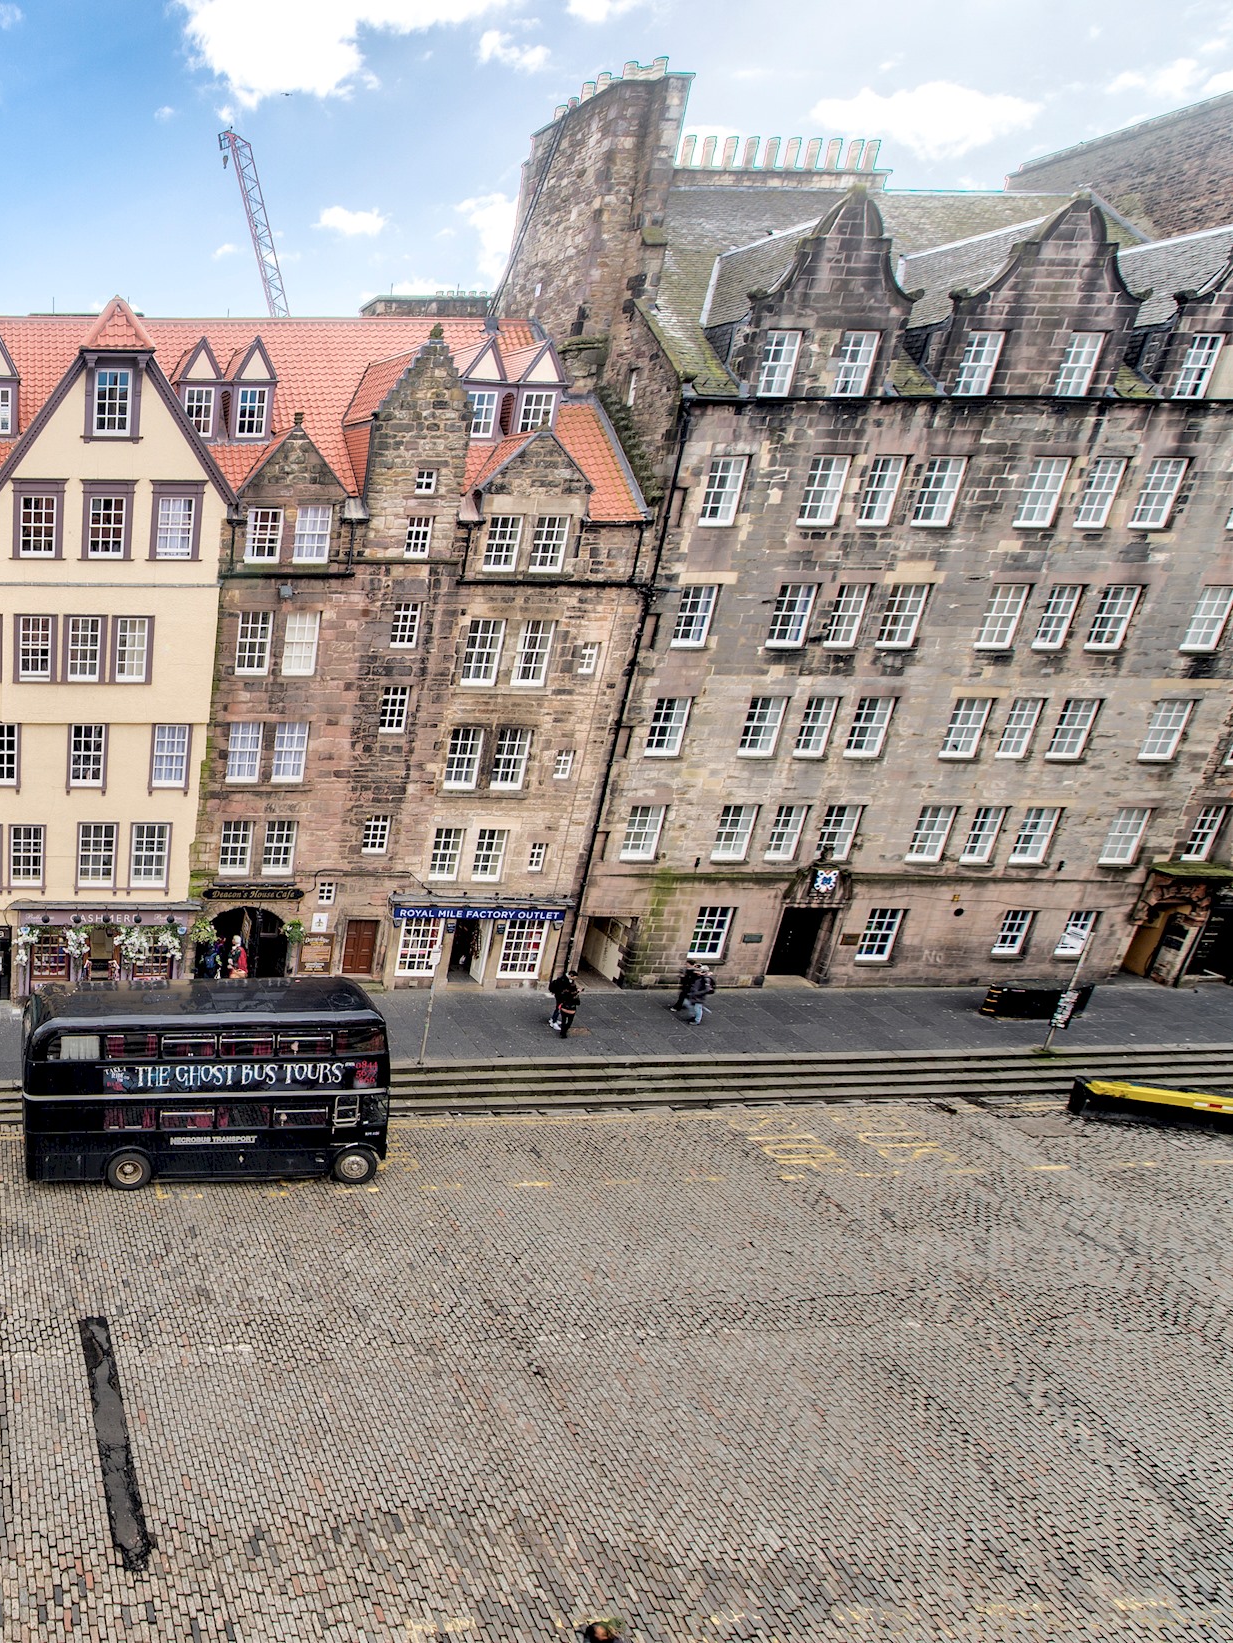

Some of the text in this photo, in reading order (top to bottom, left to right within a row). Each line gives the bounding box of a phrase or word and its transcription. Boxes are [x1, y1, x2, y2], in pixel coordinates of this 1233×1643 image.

[212, 890, 248, 898] Deacon's
[249, 890, 275, 898] House
[399, 909, 560, 920] ROYAL MILE FACTORY OUTLET
[355, 1060, 378, 1069] 0844
[135, 1065, 171, 1088] THE
[175, 1064, 237, 1086] GHOST
[241, 1063, 278, 1085] BUS
[283, 1062, 344, 1084] TOURS
[170, 1135, 258, 1145] NECROBUS TRANSPORT
